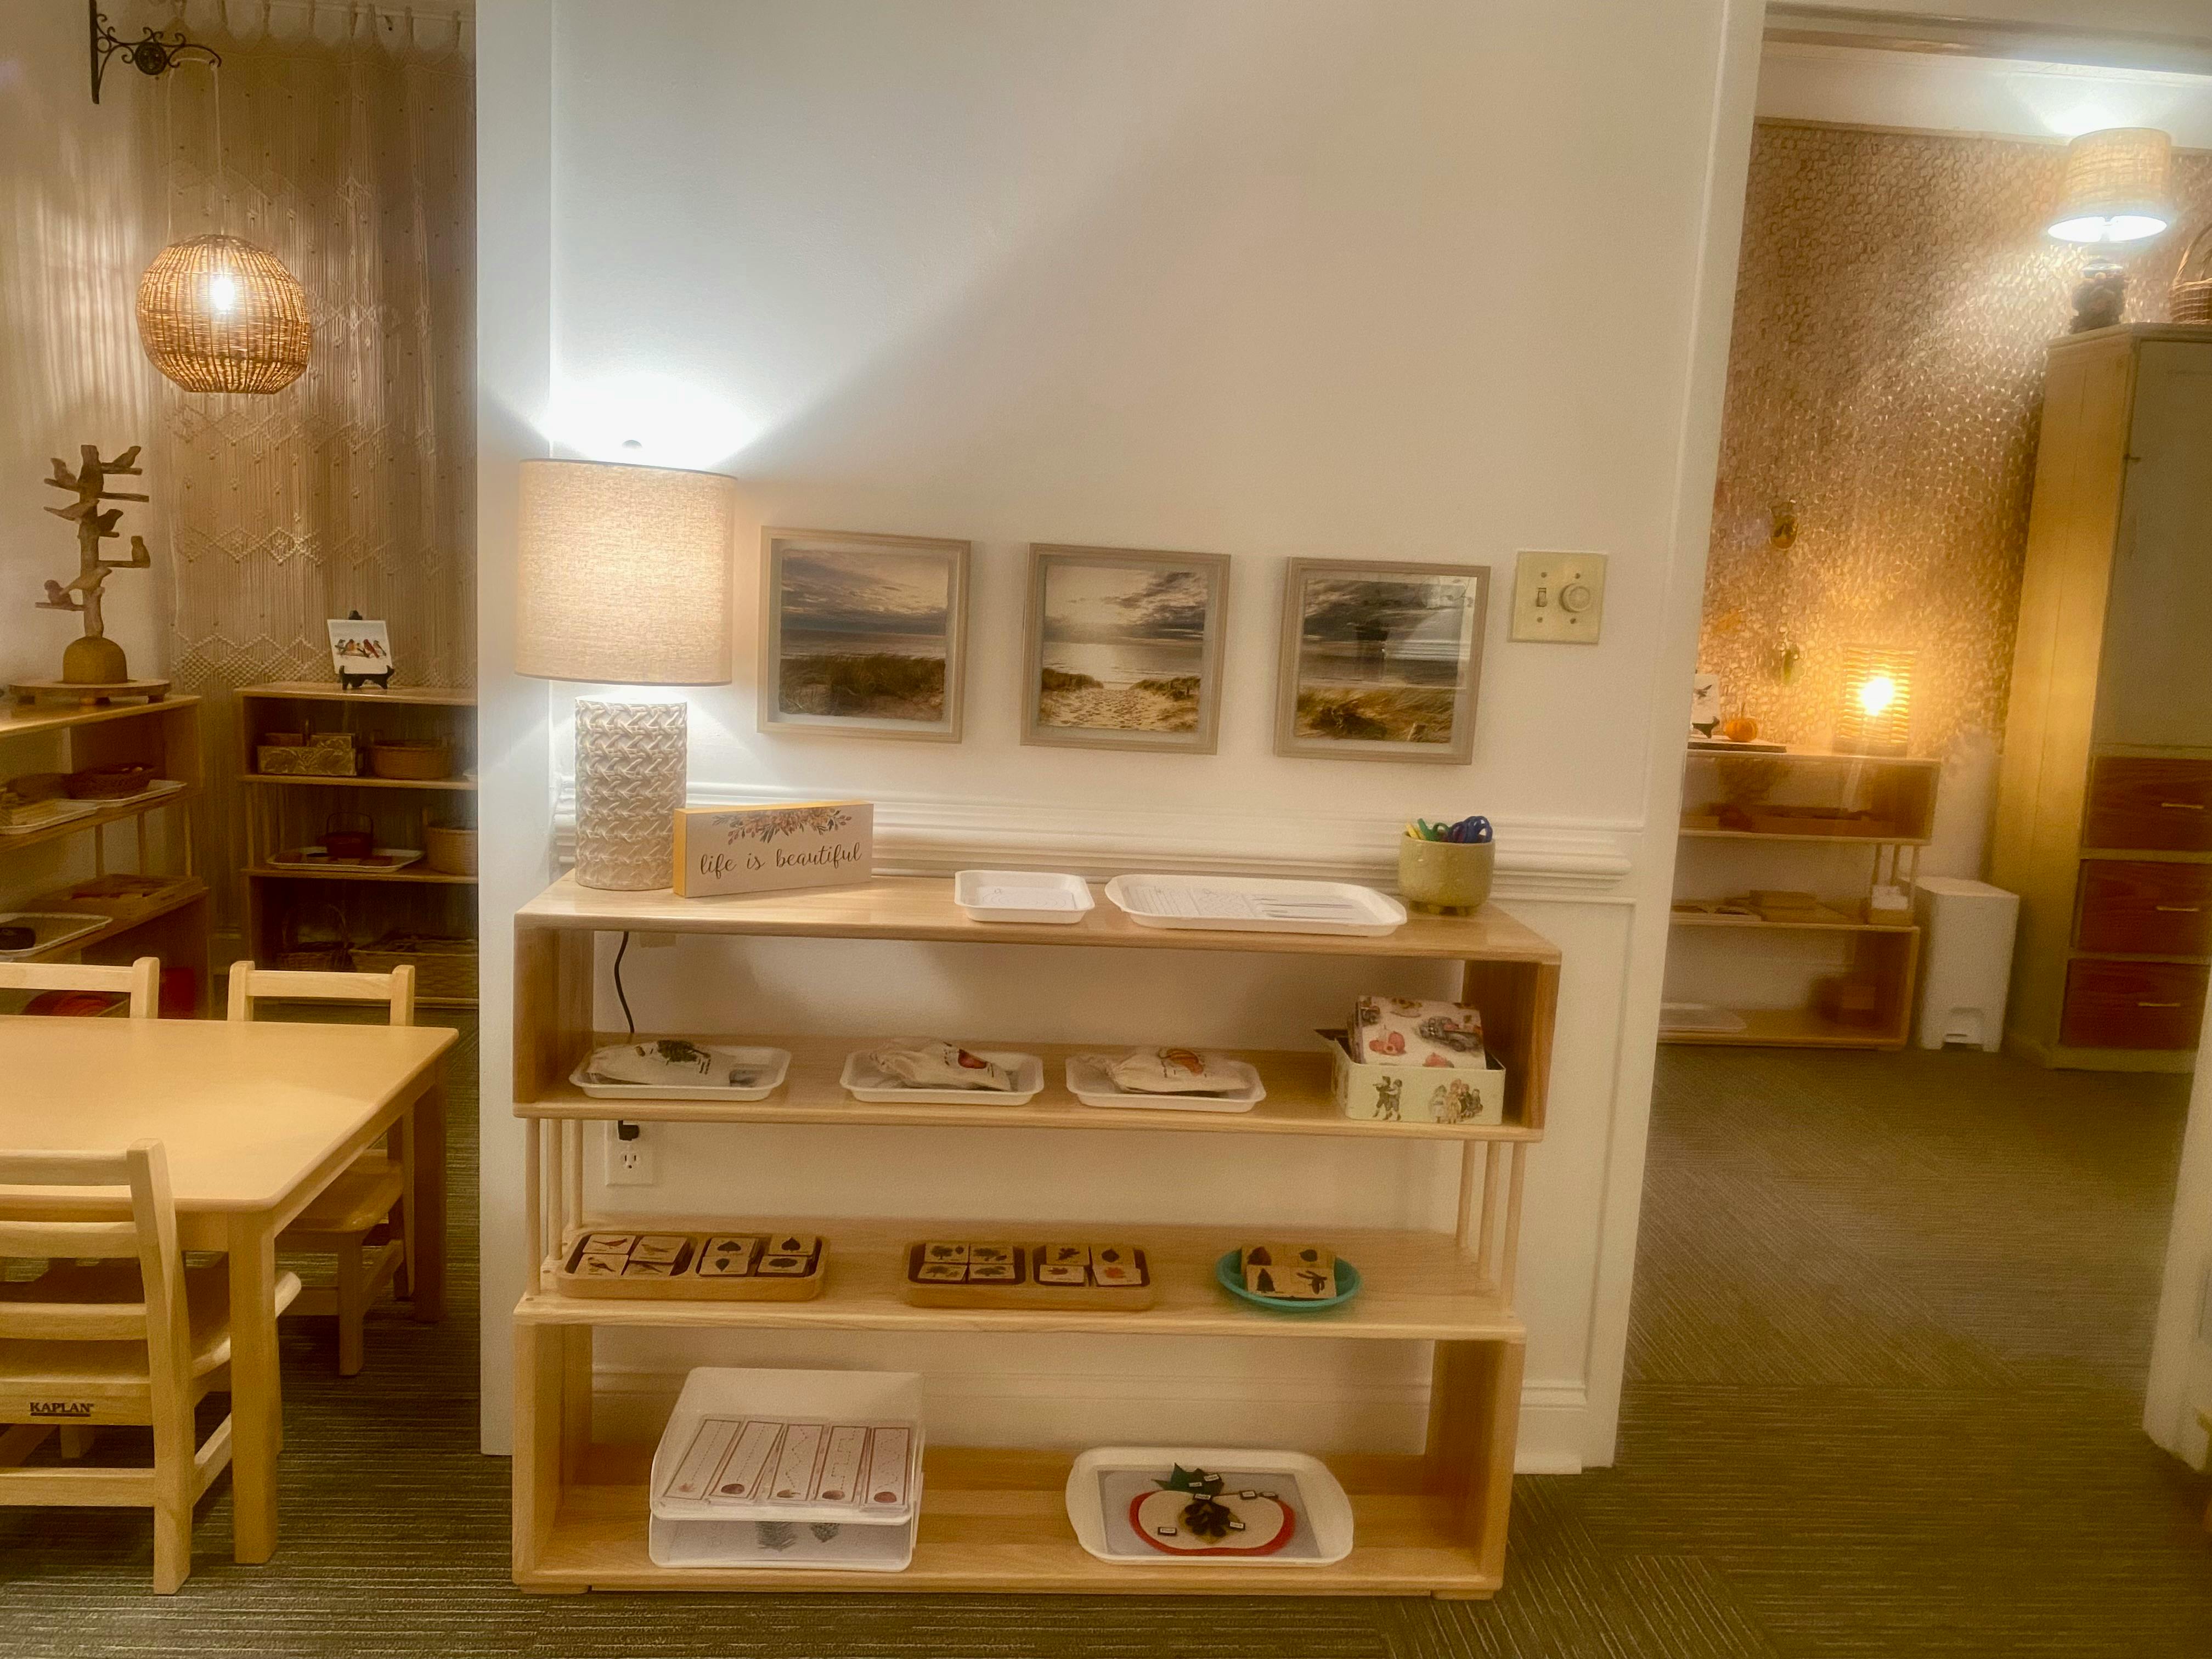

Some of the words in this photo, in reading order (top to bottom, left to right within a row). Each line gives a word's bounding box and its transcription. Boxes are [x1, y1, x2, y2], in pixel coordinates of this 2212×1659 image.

[700, 853, 736, 879] life
[747, 853, 766, 871] is
[776, 842, 862, 869] beautiful
[30, 1402, 91, 1413] KAPLAN
